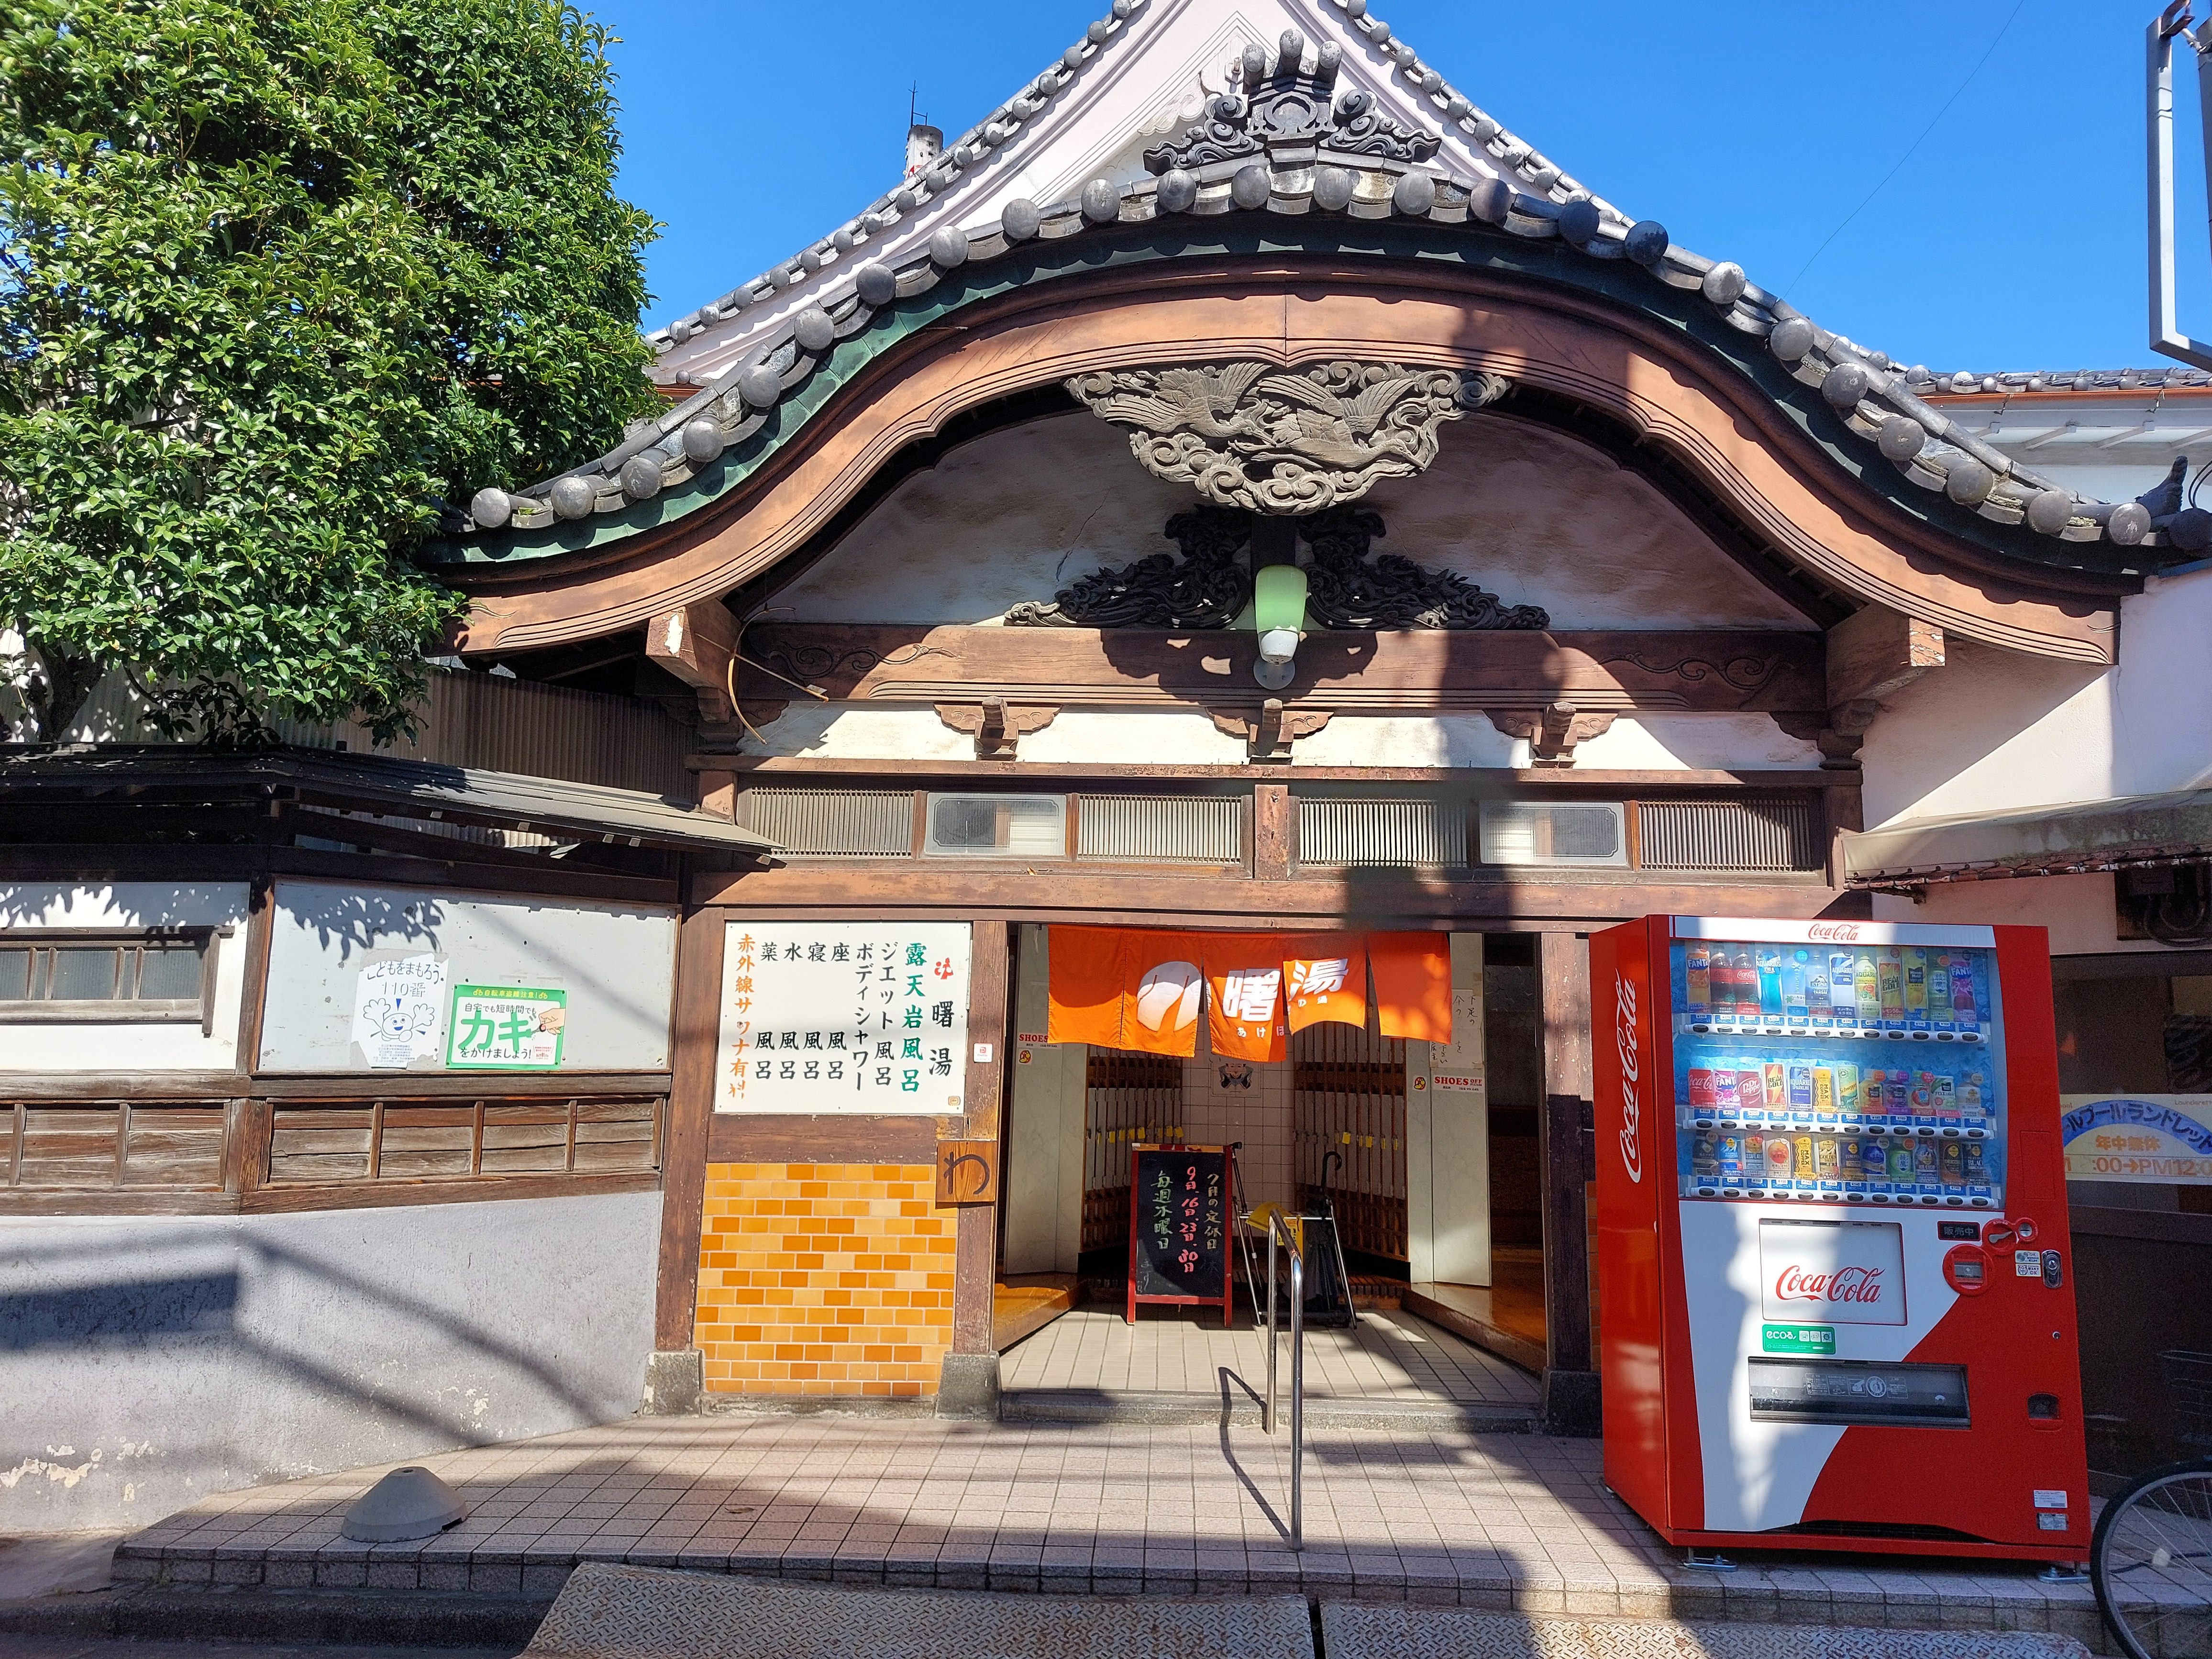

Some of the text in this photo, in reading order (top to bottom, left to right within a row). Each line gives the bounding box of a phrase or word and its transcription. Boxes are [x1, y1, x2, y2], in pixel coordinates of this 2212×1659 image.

[1808, 924, 1860, 940] Coca-Cola
[382, 982, 426, 997] 110番
[465, 1003, 536, 1014] 自宅でも短時間でも
[852, 942, 874, 1091] ボディシャワー
[901, 942, 927, 1092] 露天岩風呂
[458, 1010, 537, 1052] カギ
[929, 1000, 954, 1077] 曙湯
[1019, 1034, 1049, 1042] SHOES
[1435, 1076, 1469, 1085] SHOES
[1616, 967, 1641, 1183] Coca-Cola
[1749, 1080, 1758, 1088] Dr
[2096, 1135, 2161, 1151] 年中無休
[943, 1151, 990, 1195] わ
[1944, 1227, 1974, 1236] 販売中
[1776, 1265, 1886, 1303] Coca-Cola
